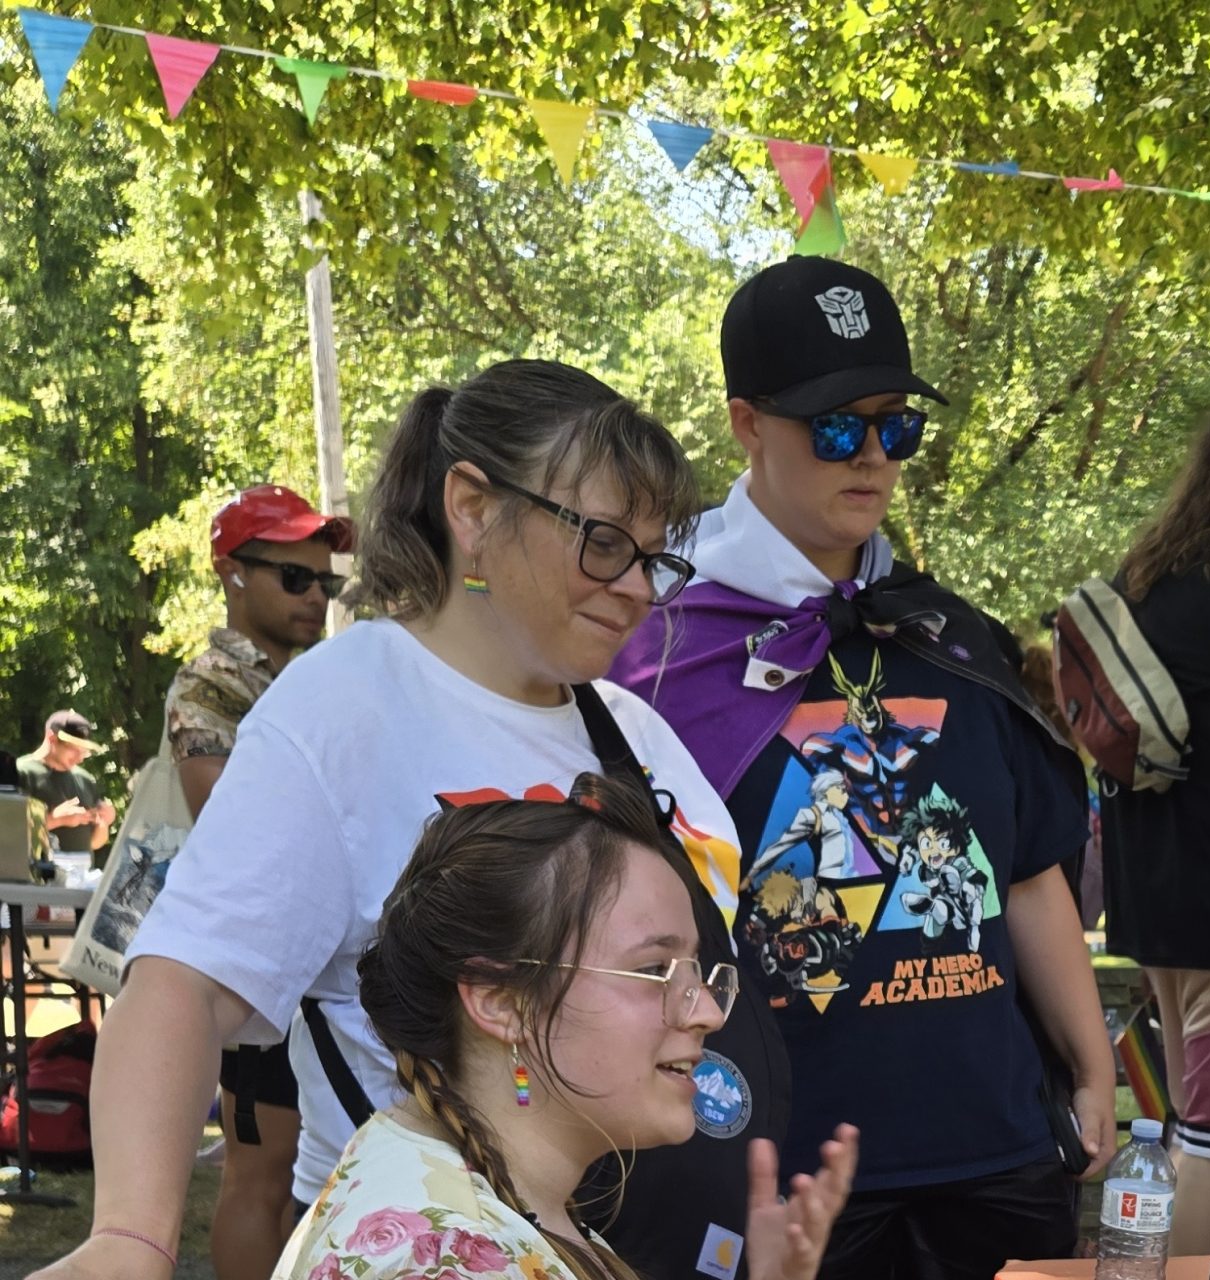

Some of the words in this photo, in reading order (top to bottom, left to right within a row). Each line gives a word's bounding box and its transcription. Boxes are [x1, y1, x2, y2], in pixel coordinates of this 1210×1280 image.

[894, 959, 927, 979] MY
[932, 953, 983, 976] HERO
[859, 965, 1005, 1006] ACADEMIA
